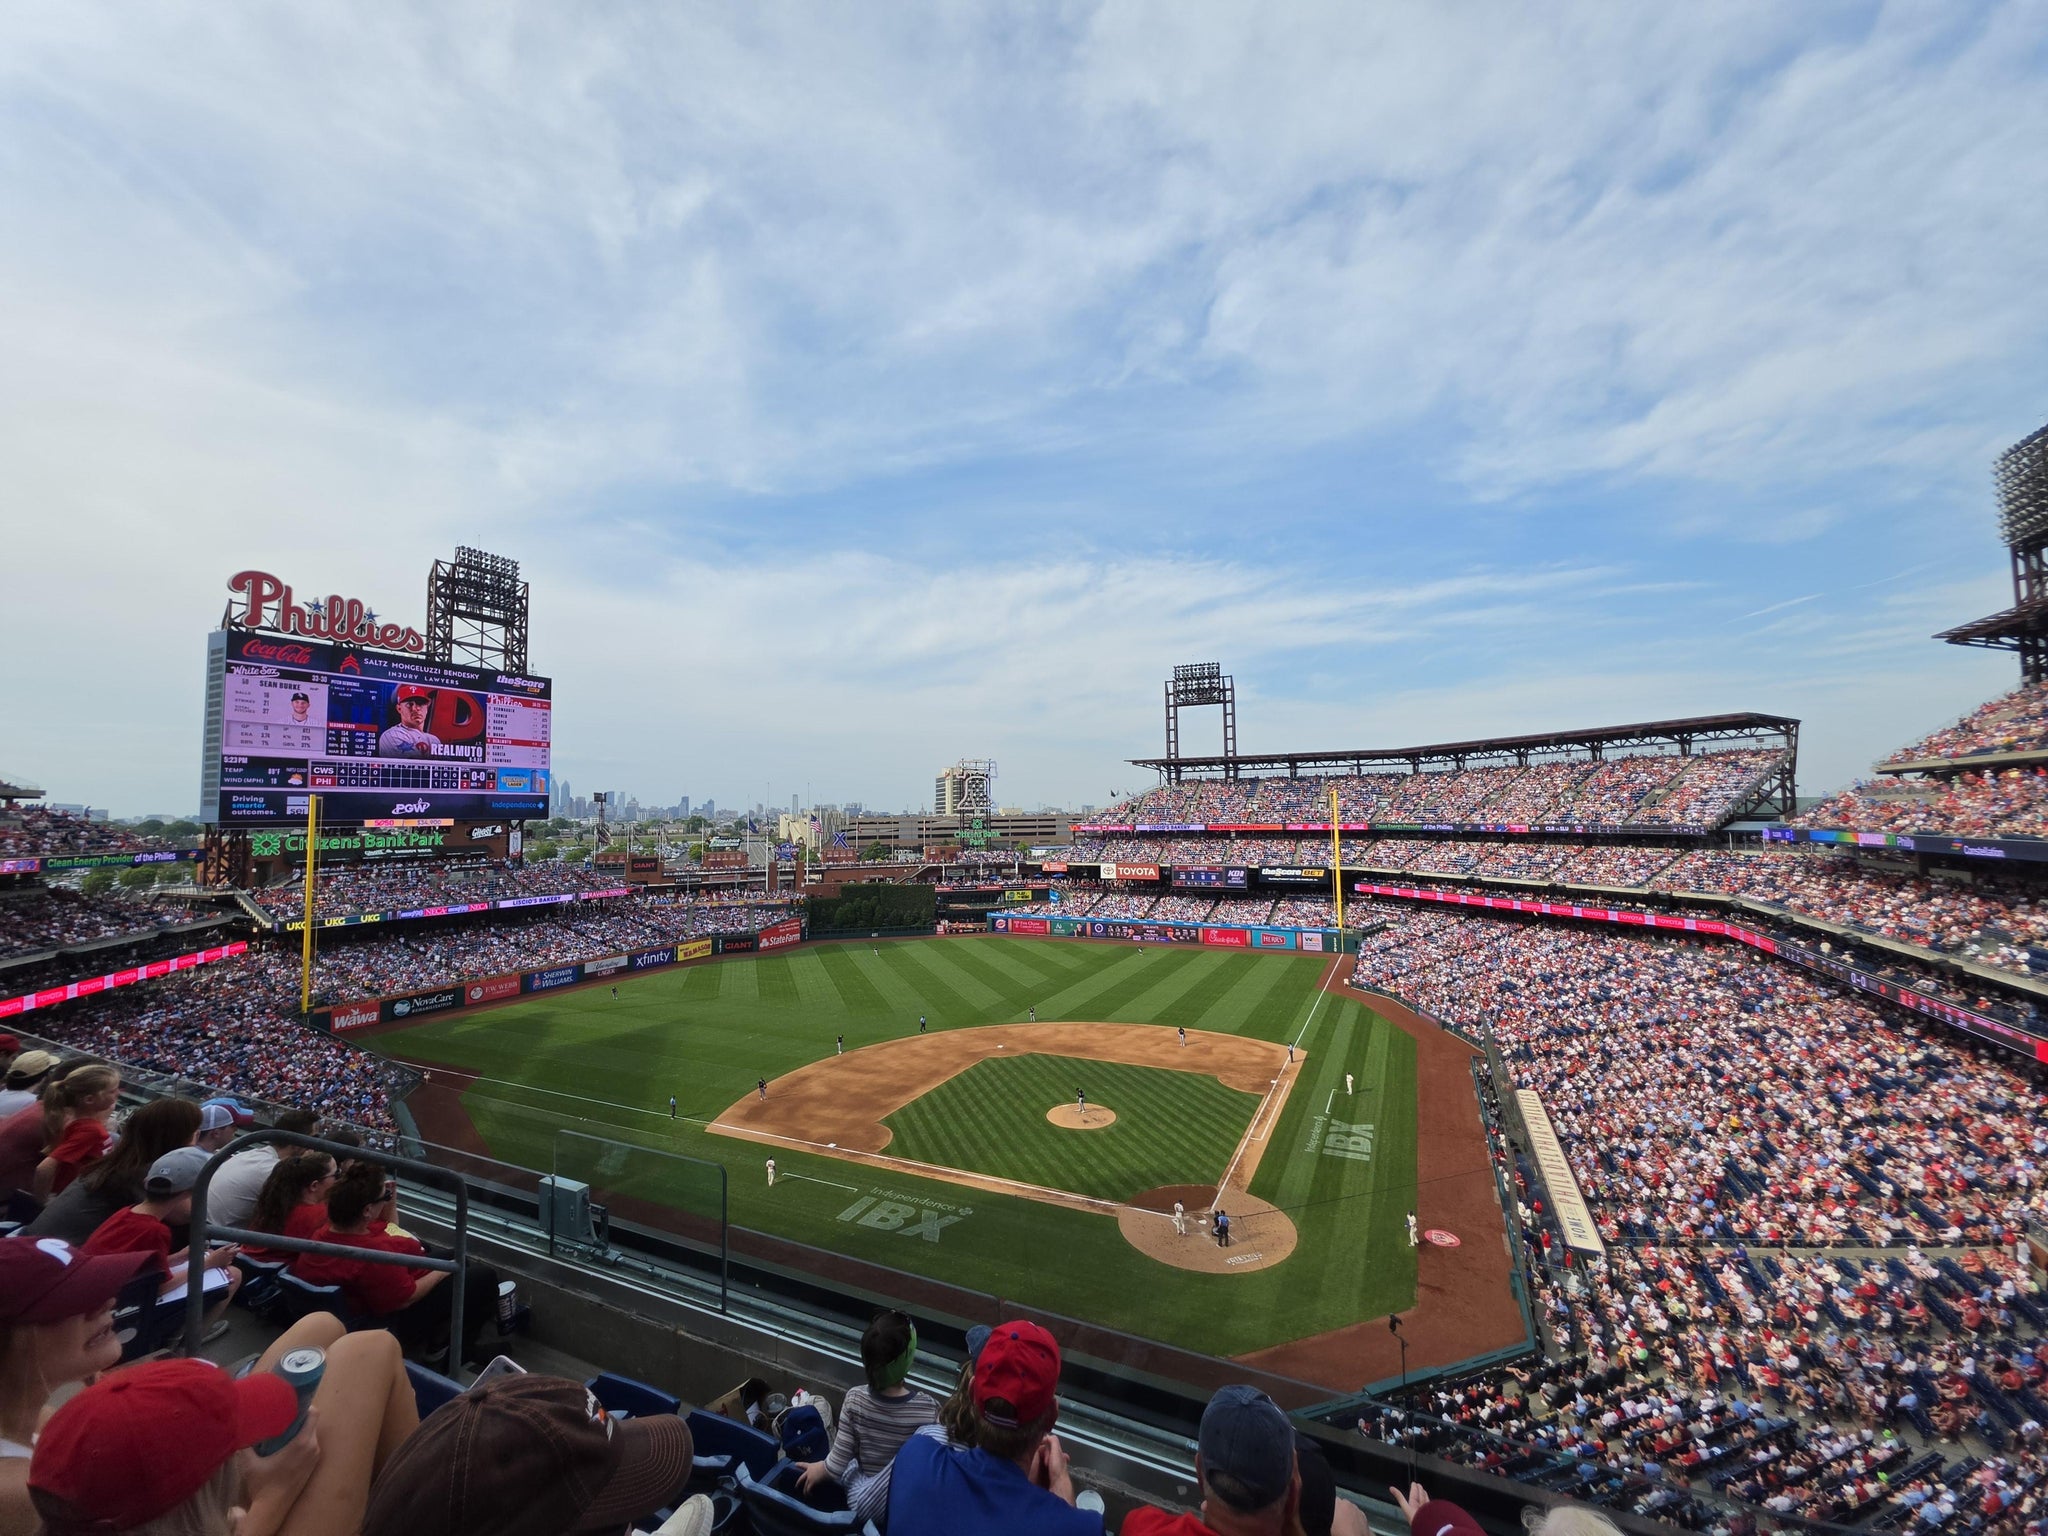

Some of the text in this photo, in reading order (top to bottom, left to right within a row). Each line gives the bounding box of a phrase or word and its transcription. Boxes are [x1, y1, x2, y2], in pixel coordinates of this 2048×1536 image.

[227, 570, 425, 653] Phillies
[242, 638, 315, 664] Coca-Cola
[230, 665, 280, 678] White Sox
[363, 658, 480, 680] SALTZ MONGELUZZI BENDESKY
[388, 671, 459, 686] INJURY LAWYERS
[496, 675, 545, 689] theScore
[259, 680, 301, 691] SEAN BURKE
[431, 743, 483, 758] REALMUTO
[471, 771, 486, 781] 0-0
[232, 795, 264, 803] Driving
[395, 802, 428, 814] PGW
[471, 825, 496, 839] GHOST
[285, 831, 444, 851] Ciizens Bank Park
[47, 857, 72, 868] Clean
[74, 855, 101, 868] Energy
[103, 853, 133, 865] Provider
[134, 853, 142, 862] of
[142, 852, 153, 862] the
[154, 851, 176, 862] Phillies
[1118, 867, 1156, 876] TOYOTA
[1261, 868, 1302, 876] theScore
[512, 895, 561, 906] LISCIO'S BAKERY
[1551, 907, 1571, 915] TOYOTA
[1583, 910, 1605, 918] TOYOTA
[324, 917, 346, 927] UKG
[360, 913, 381, 923] UKG
[1619, 914, 1643, 922] TOYOTA
[1657, 917, 1683, 927] TOYOTA
[1698, 922, 1724, 931] TOYOTA
[724, 941, 753, 950] GIANT
[636, 950, 671, 967] xfinity
[148, 965, 167, 974] TOYOTA
[542, 968, 573, 980] SHERWIN
[115, 972, 137, 982] TOYOTA
[1850, 972, 1867, 988] 0-0
[80, 981, 103, 992] TOYOTA
[498, 981, 518, 991] WEBB
[37, 991, 64, 1003] TOYOTA
[411, 993, 454, 1008] NovaCare
[334, 1010, 379, 1030] Wawa
[1322, 1118, 1375, 1161] IBX
[1532, 1129, 1581, 1206] PHILADELPHIA
[870, 1186, 957, 1212] Independence
[835, 1195, 964, 1243] IBX
[1566, 1216, 1589, 1240] HOME
